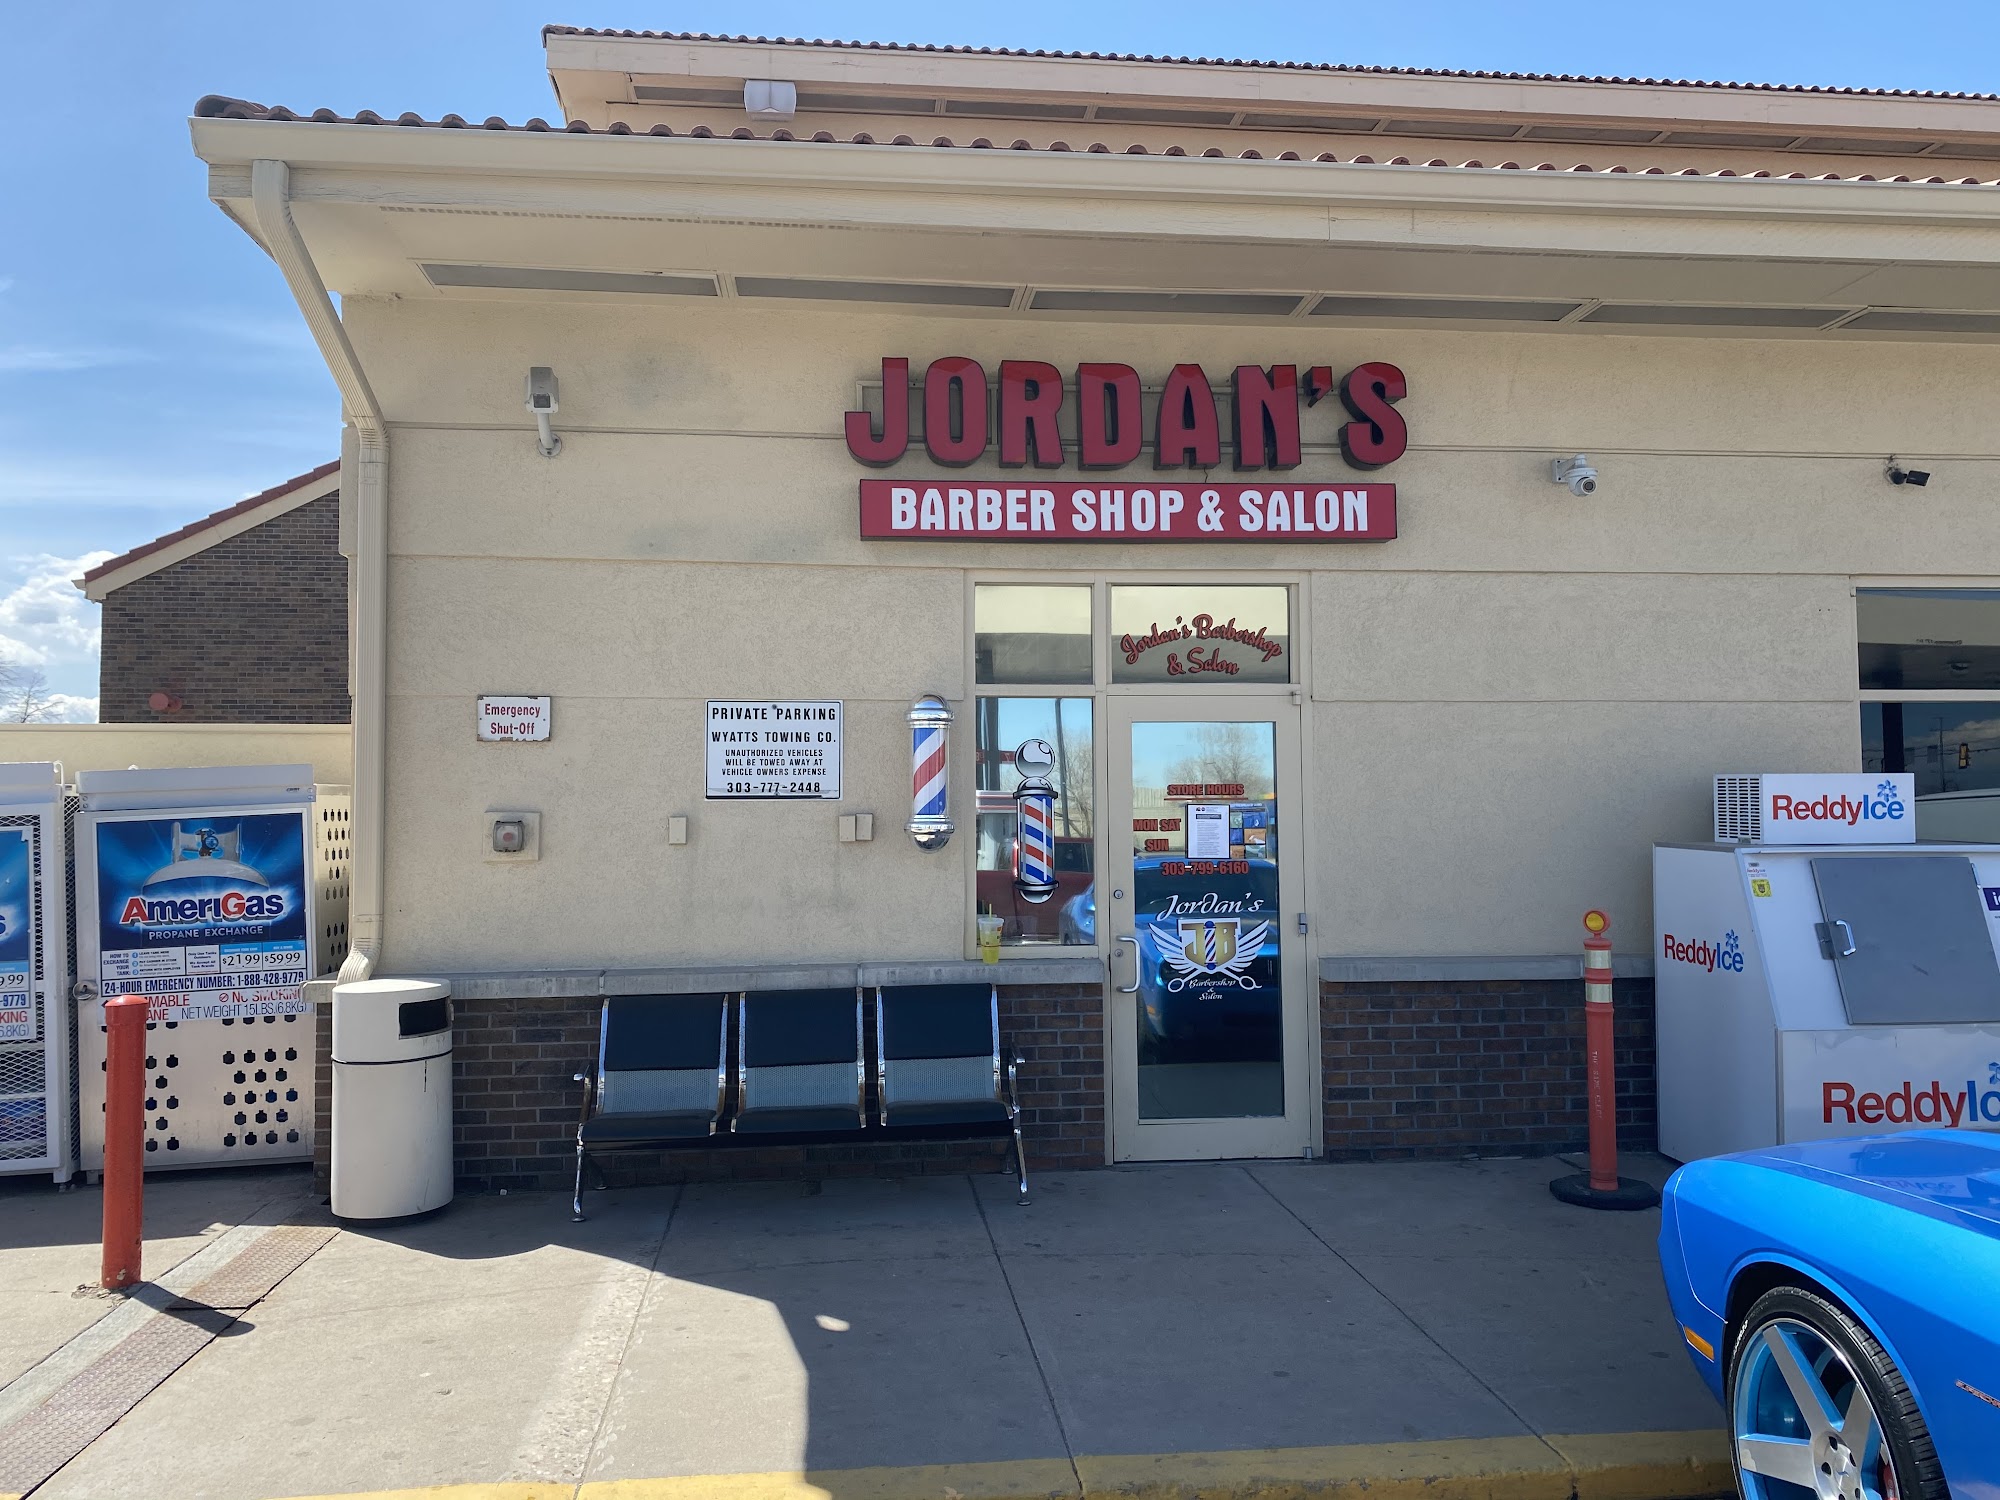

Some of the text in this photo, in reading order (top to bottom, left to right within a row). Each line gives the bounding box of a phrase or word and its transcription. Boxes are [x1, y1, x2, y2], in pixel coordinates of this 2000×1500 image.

[845, 357, 1407, 470] JORDAN'S
[891, 487, 1368, 532] BARBER SHOP & SALON
[1120, 613, 1283, 664] Jordan's Barbershop
[1167, 647, 1240, 676] & Salon
[485, 703, 541, 718] Emergency
[712, 707, 836, 720] PRIVATE PARKING
[490, 722, 535, 735] Shut-Off
[712, 731, 836, 742] WYATTS TOWING CO.
[725, 749, 823, 757] UNAUTHORIZED VEHICLES
[722, 768, 827, 776] VEHICLE OWNERS EXPENSE
[727, 782, 820, 793] 303-777-2448
[1167, 783, 1245, 796] STORE HOURS
[1772, 794, 1904, 825] ReddyIce
[1133, 818, 1181, 831] MON SAT
[1144, 839, 1169, 852] SUN
[1160, 861, 1249, 876] 303-799-6160
[119, 892, 285, 926] AmeriGas
[1150, 892, 1265, 922] Jordan's
[149, 925, 263, 941] PROPANE EXCHANGE
[222, 953, 260, 967] $21.99
[264, 952, 301, 966] $59.99
[1664, 933, 1744, 973] ReddyIce
[104, 971, 304, 995] 24-HOUR EMERGENCY NUMBER: 1-888-428-9779
[1188, 978, 1237, 990] Barbershop
[145, 993, 190, 1008] MABLE
[1199, 992, 1223, 1000] Salon
[181, 1007, 202, 1020] NET
[203, 1004, 241, 1018] WEIGHT
